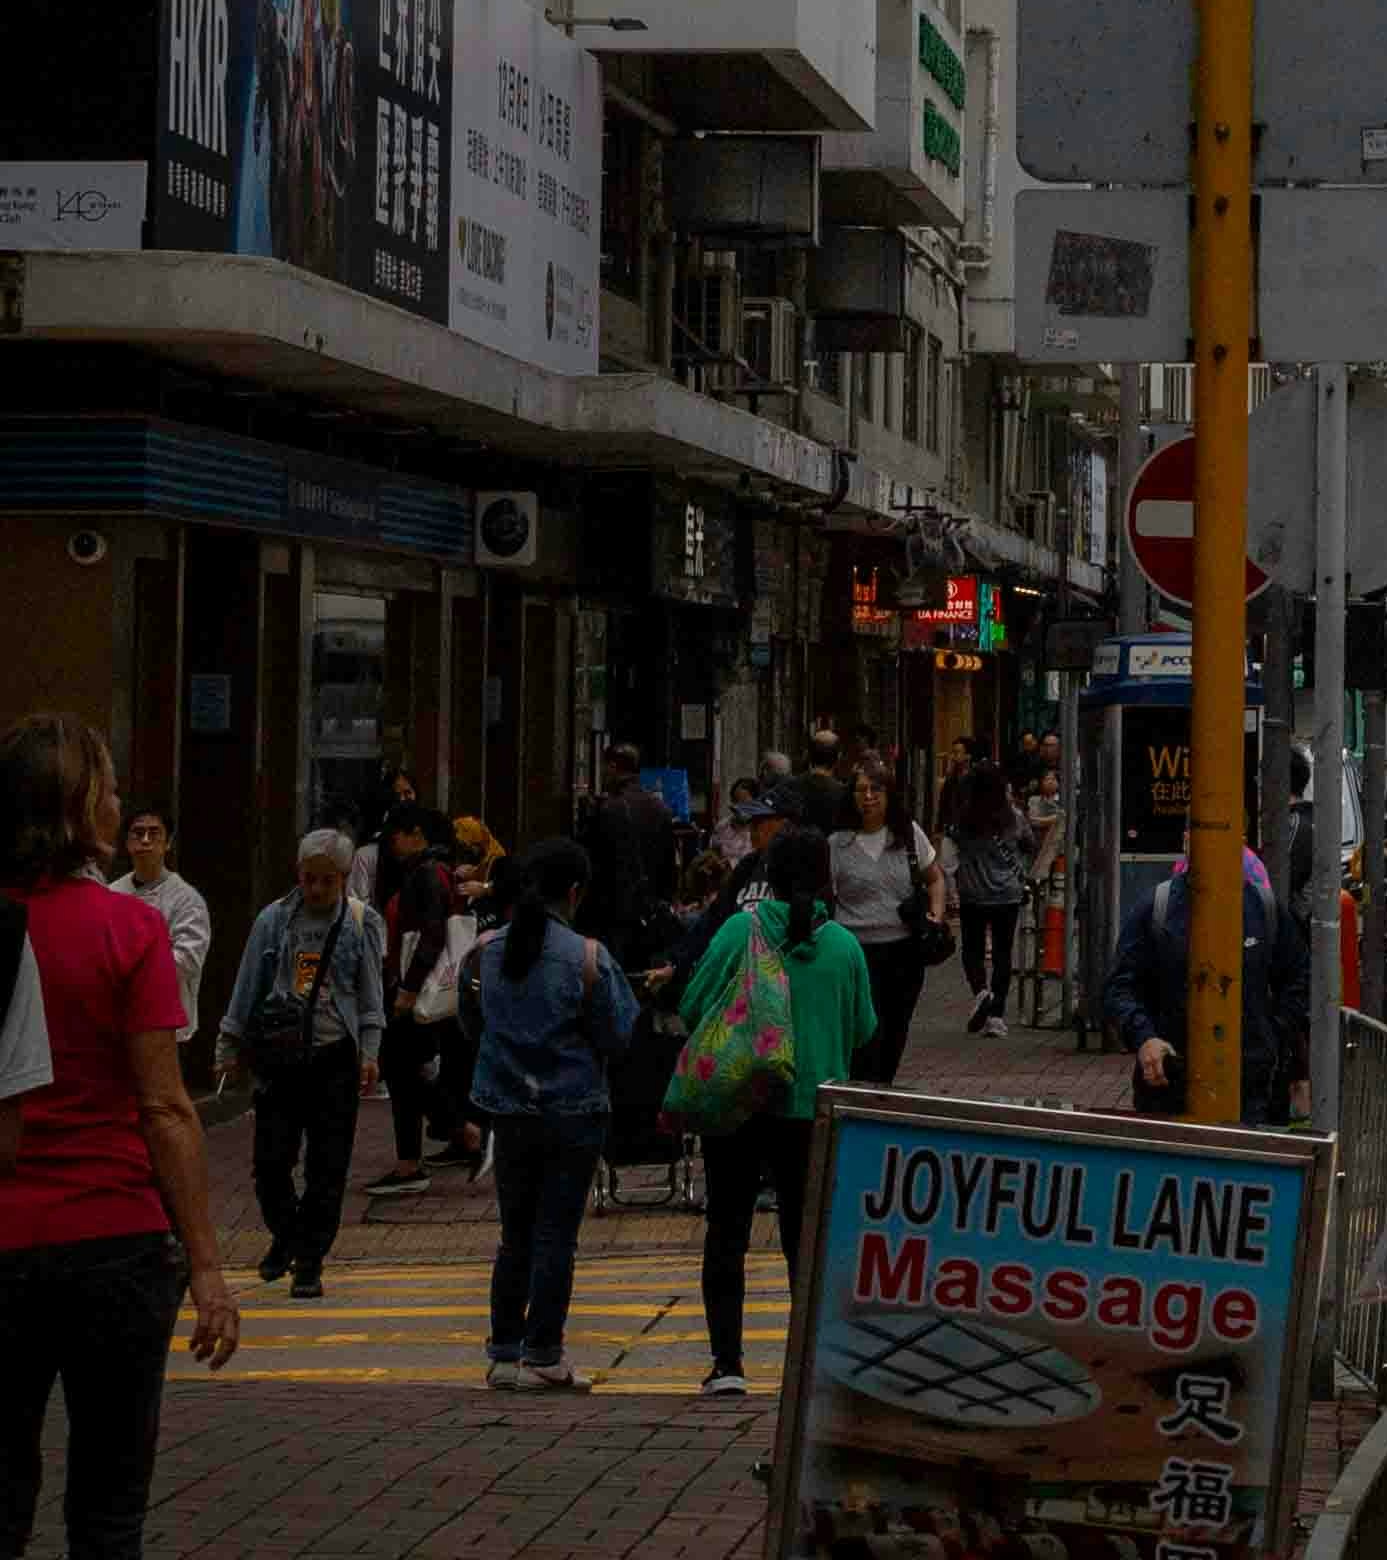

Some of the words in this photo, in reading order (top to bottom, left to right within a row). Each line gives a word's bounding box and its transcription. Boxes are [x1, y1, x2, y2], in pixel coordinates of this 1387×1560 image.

[933, 608, 974, 621] FINANCE
[1161, 655, 1192, 666] PCC
[1148, 744, 1192, 777] Wi
[864, 1143, 1095, 1244] JOYFUL
[1111, 1171, 1274, 1264] LANE
[855, 1233, 1259, 1351] Massage
